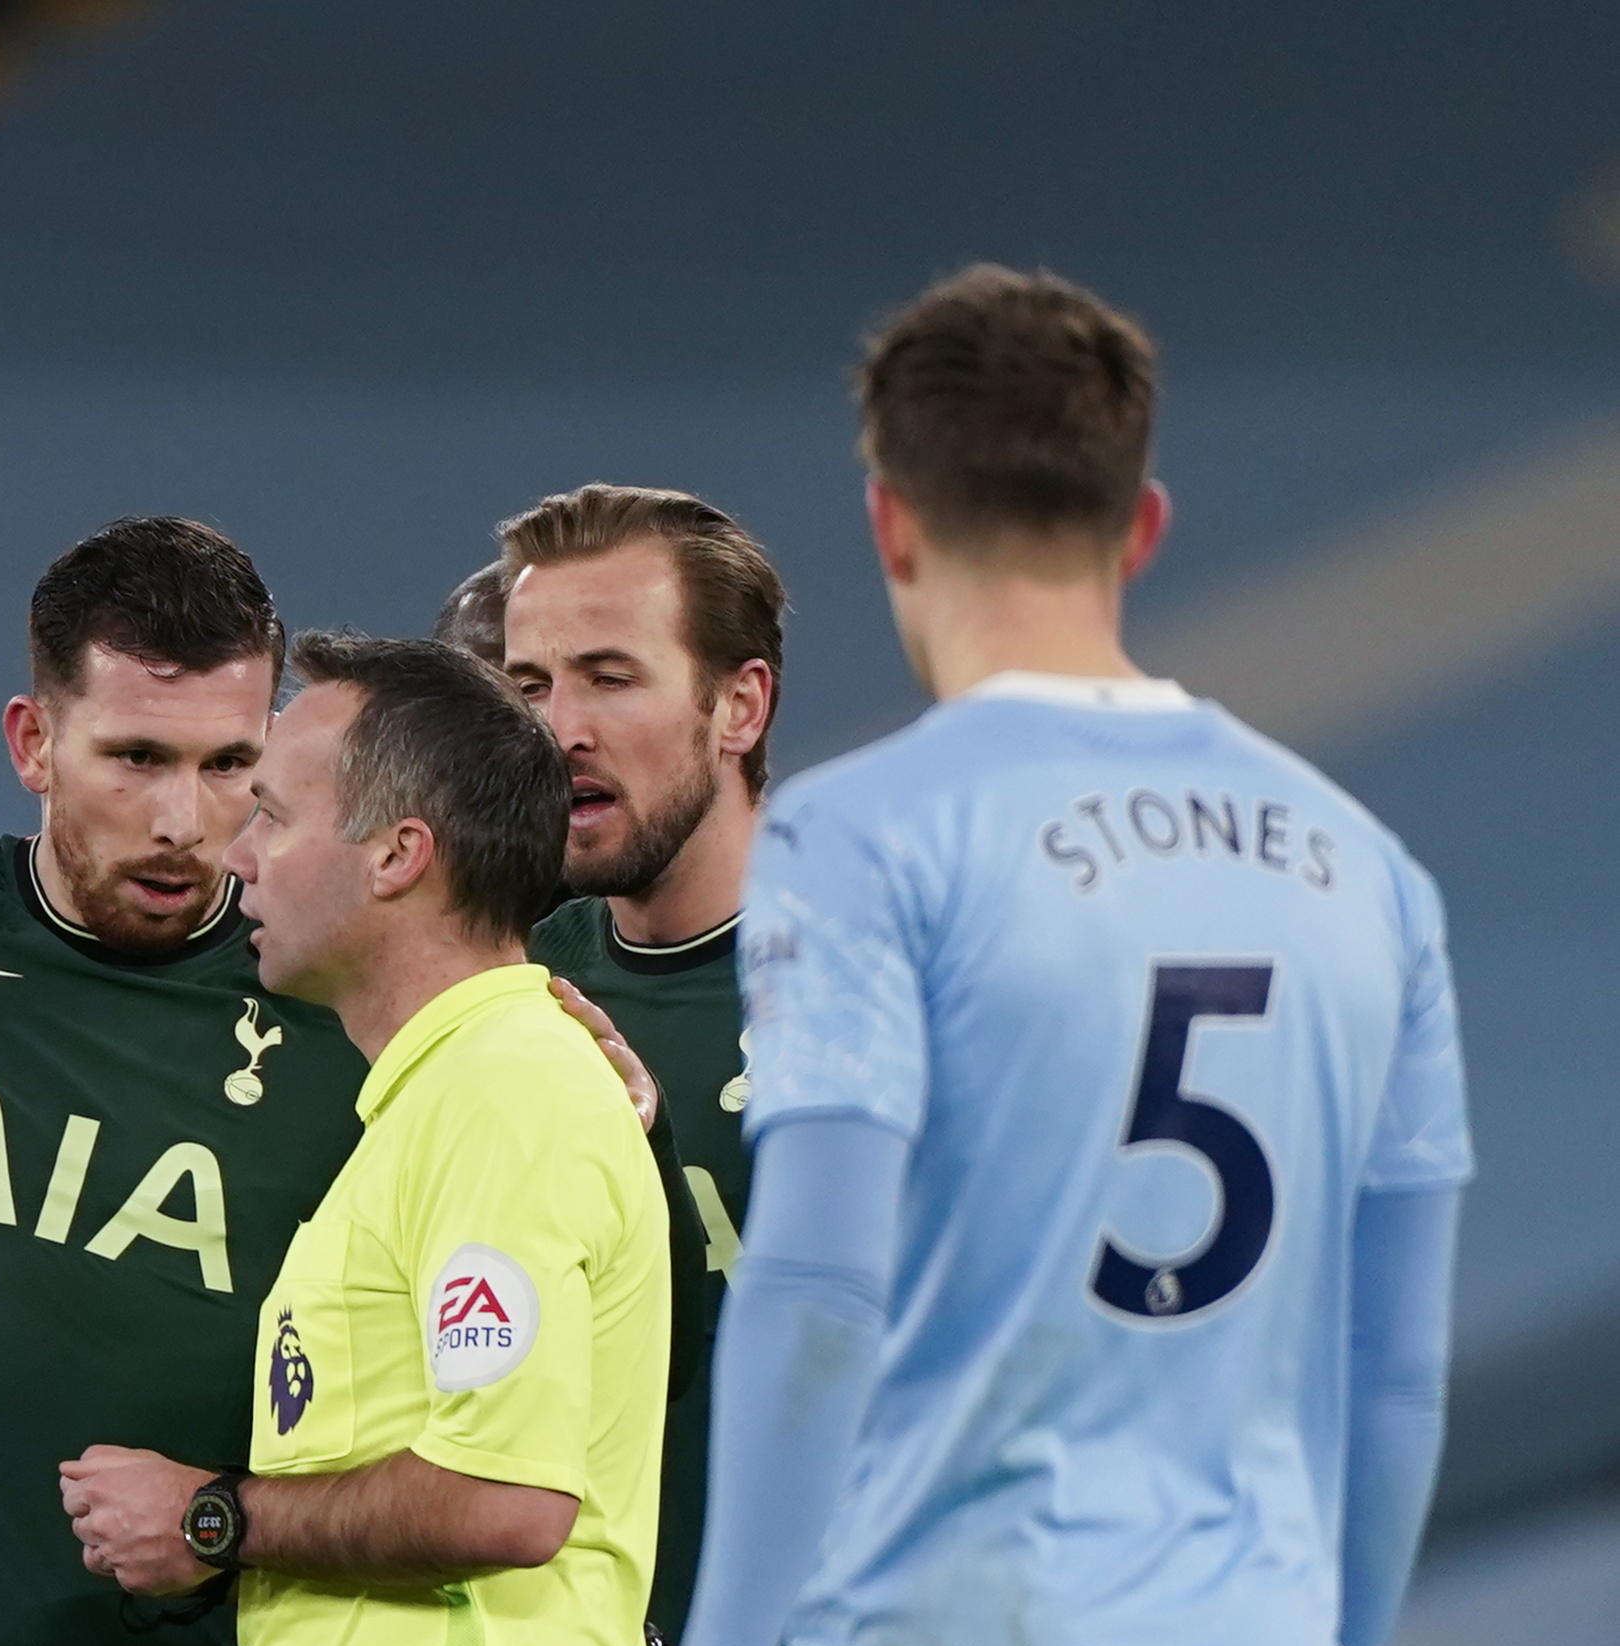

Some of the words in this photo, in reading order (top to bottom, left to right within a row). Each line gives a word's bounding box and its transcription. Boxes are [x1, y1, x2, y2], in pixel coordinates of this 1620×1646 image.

[1040, 788, 1338, 893] STONES
[1086, 957, 1281, 1327] 5
[434, 1327, 513, 1358] ORTS
[438, 1276, 512, 1333] EA
